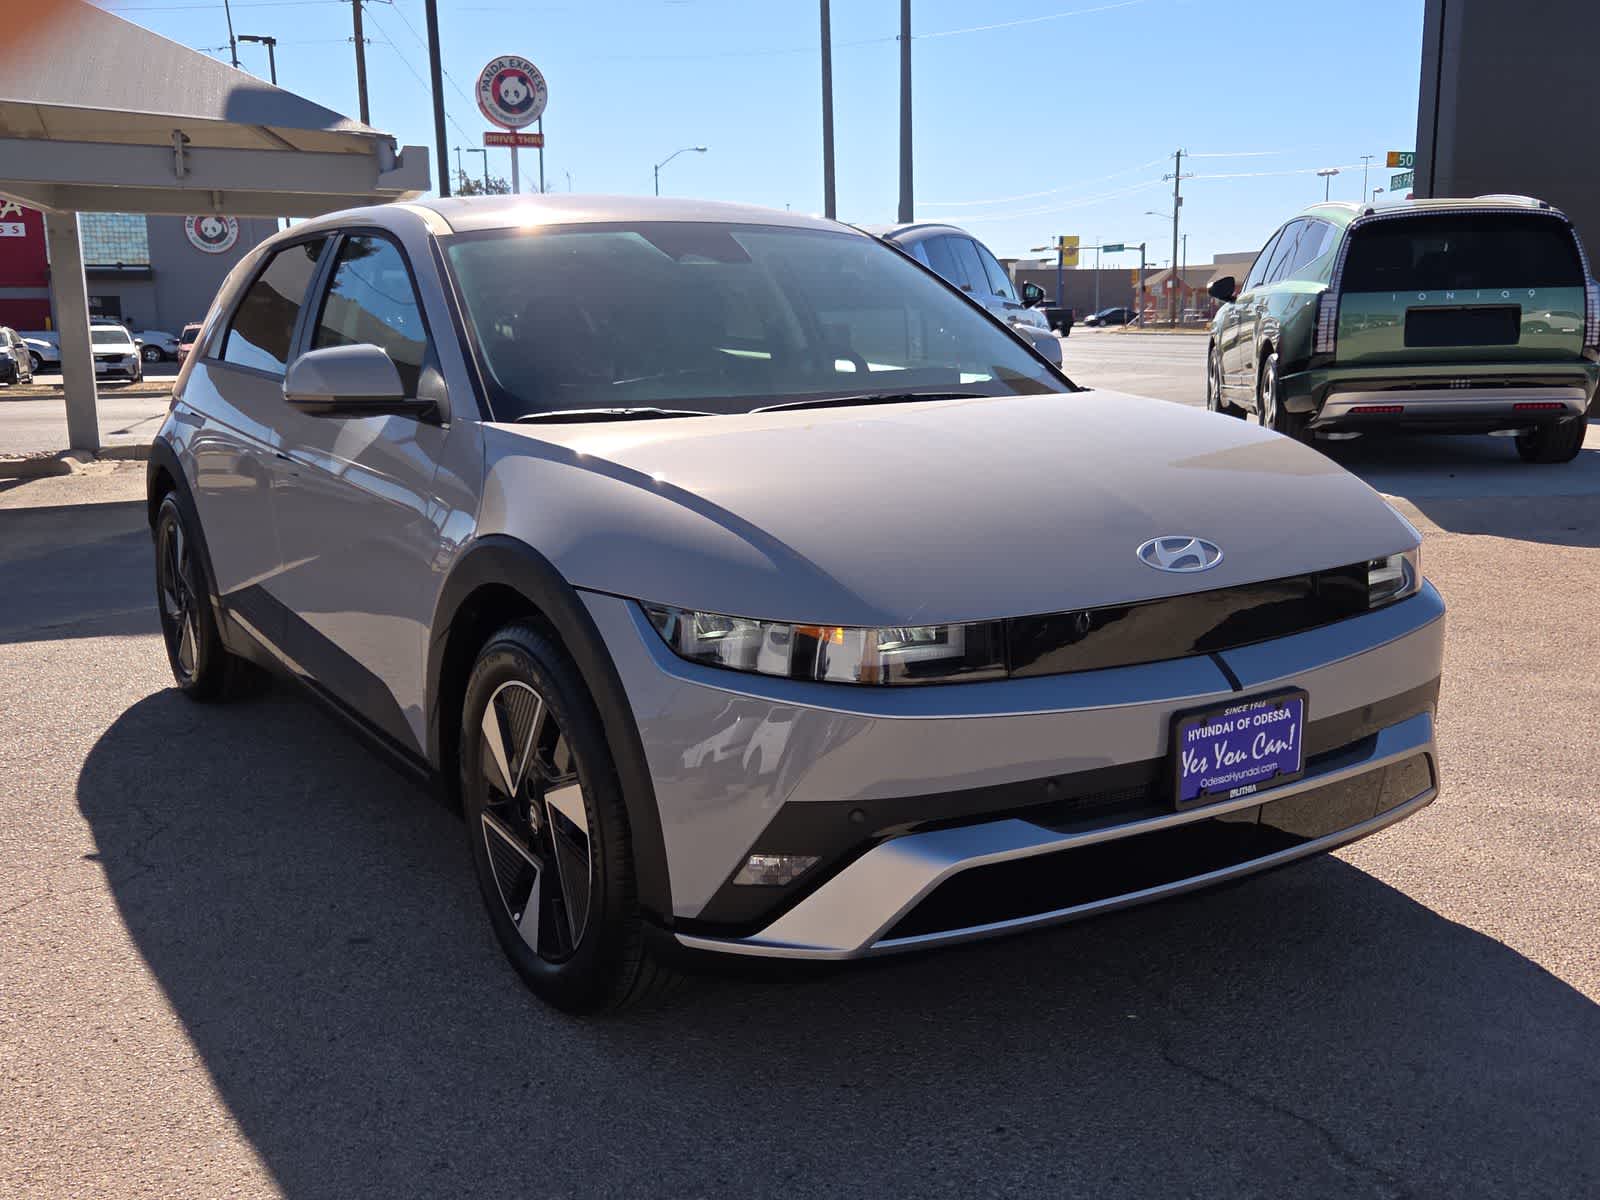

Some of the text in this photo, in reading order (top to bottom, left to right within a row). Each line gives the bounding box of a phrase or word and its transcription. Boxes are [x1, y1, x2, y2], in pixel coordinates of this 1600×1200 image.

[482, 59, 544, 91] PANDA EXPRESS
[487, 135, 514, 145] DRIVE
[1224, 704, 1248, 716] SINCE
[1188, 708, 1291, 742] HYUNDAI OF ODESSA
[1182, 723, 1295, 777] Yes You Can!
[1200, 762, 1278, 788] OdessaHyundai.com
